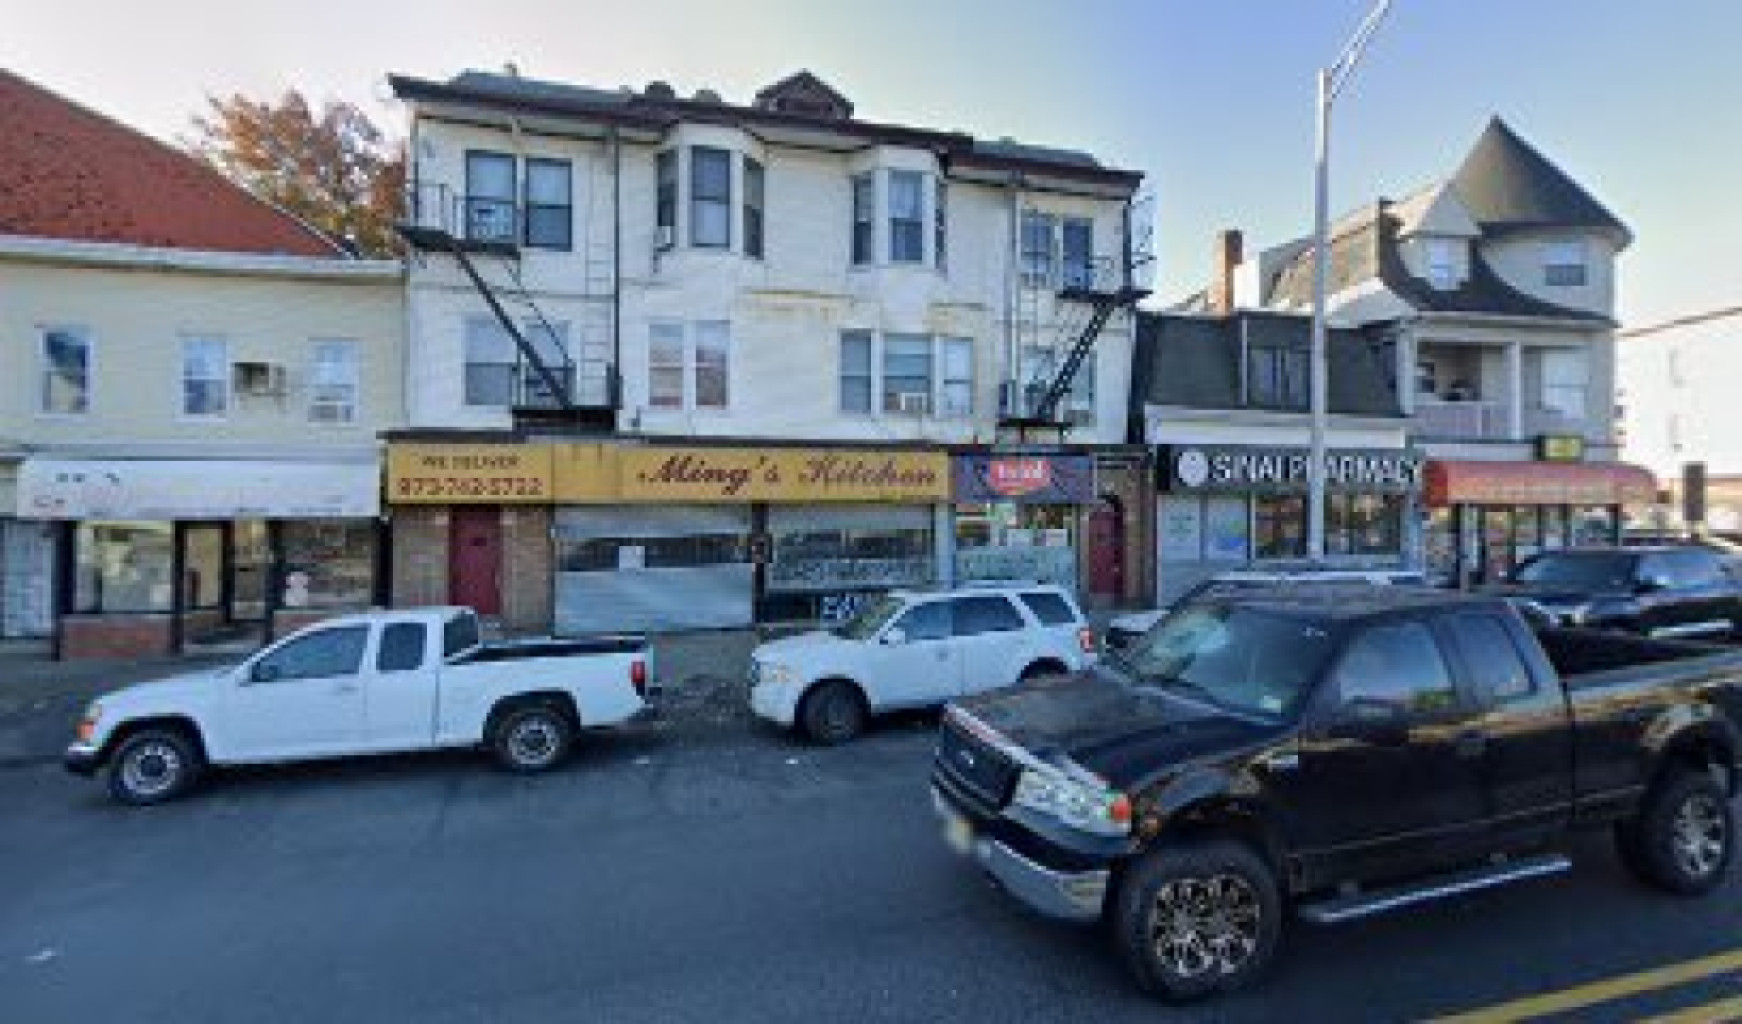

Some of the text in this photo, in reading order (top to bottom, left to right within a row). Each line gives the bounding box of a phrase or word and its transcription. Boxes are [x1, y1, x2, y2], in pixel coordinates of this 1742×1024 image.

[636, 455, 937, 495] Ming's Kitchen
[1211, 455, 1282, 483] SINAI
